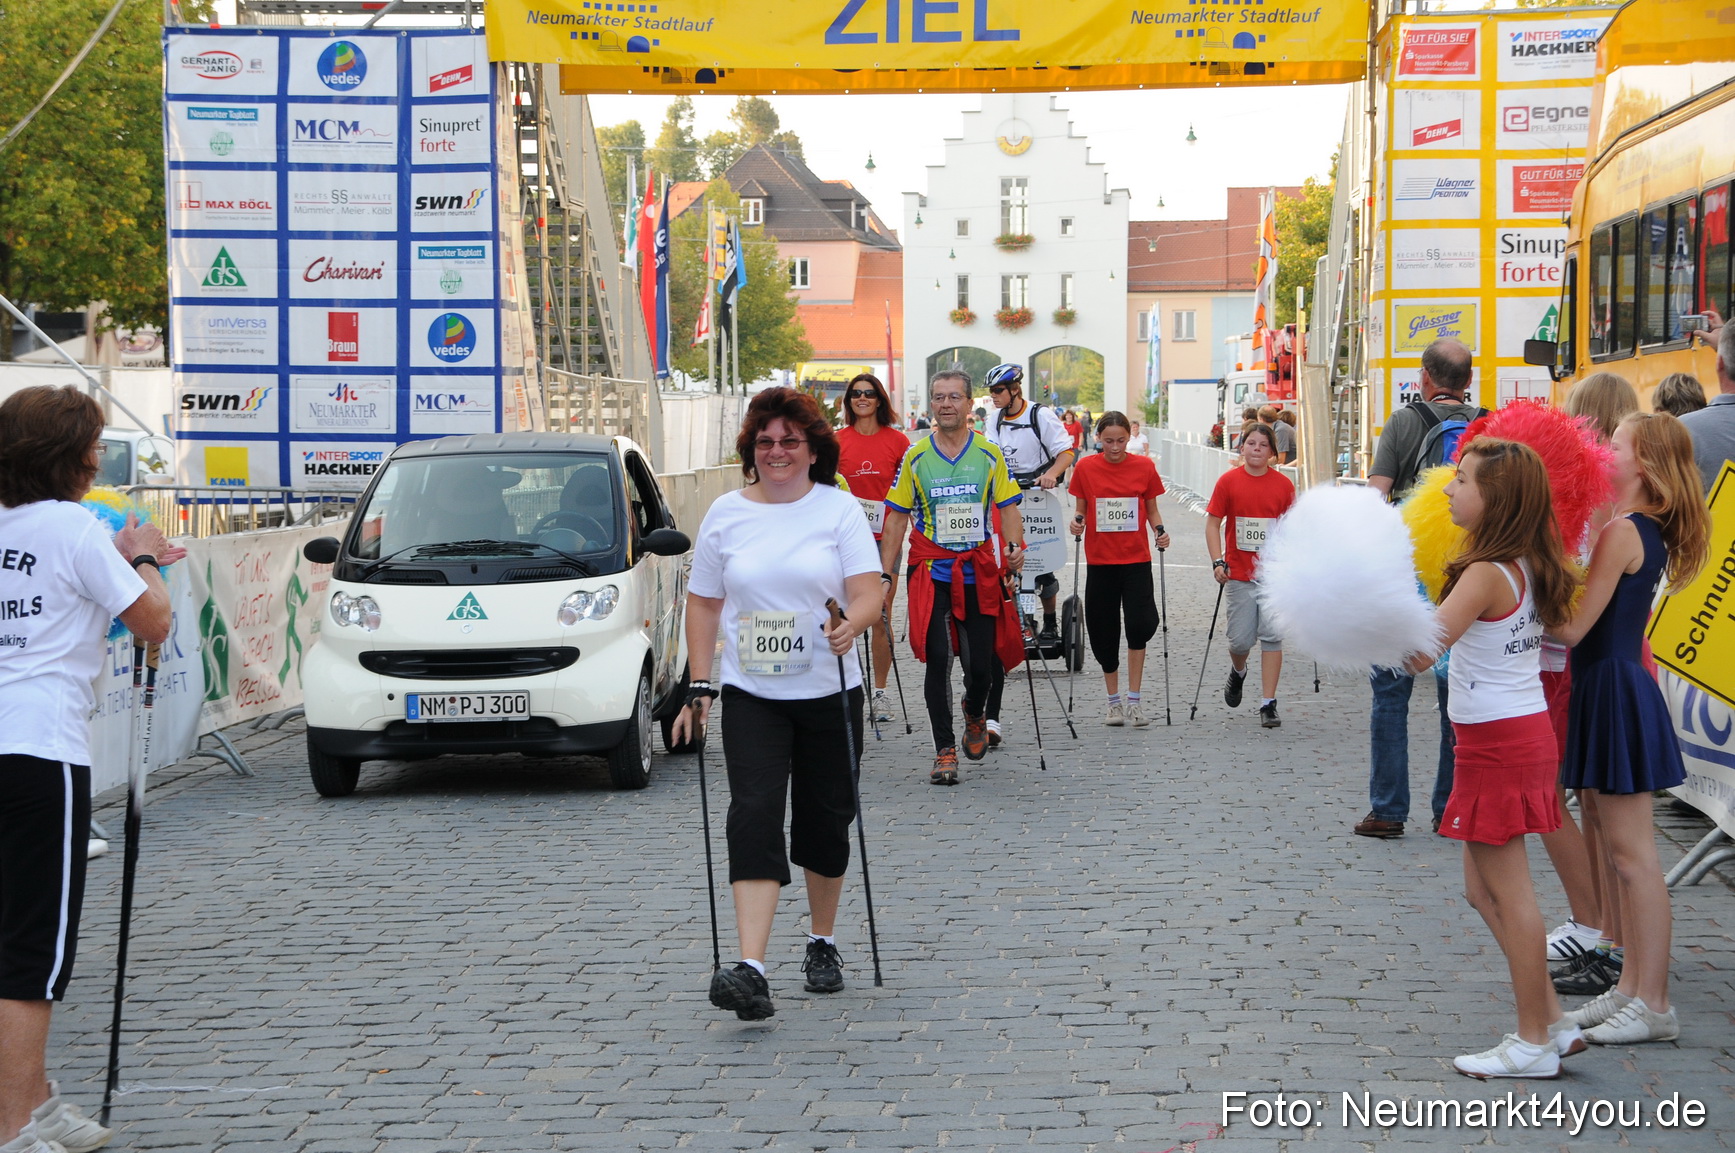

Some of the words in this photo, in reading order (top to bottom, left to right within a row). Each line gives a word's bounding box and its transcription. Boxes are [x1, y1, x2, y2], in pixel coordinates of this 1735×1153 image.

[526, 10, 628, 28] Neumarkter
[633, 15, 714, 32] Stadtlauf
[1130, 7, 1234, 24] Neumarkter
[1239, 7, 1322, 23] Stadtlauf
[1405, 34, 1426, 43] GUT
[1427, 32, 1448, 43] FÜR
[1449, 32, 1470, 43] SIE!
[1524, 28, 1598, 42] INTERSPORT
[1511, 41, 1597, 57] HACKNER
[181, 56, 230, 65] GERHART
[204, 65, 237, 73] JANIG
[322, 72, 361, 85] vedes
[440, 72, 461, 86] DEHN
[294, 118, 360, 141] MCM
[419, 117, 481, 136] Sinupret
[1425, 126, 1449, 139] DEHN
[420, 137, 456, 153] forte
[1520, 170, 1541, 180] GUT
[1543, 168, 1564, 179] FÜR
[1436, 177, 1475, 190] Wagner
[205, 200, 235, 209] MAX
[239, 198, 273, 210] BÖGL
[415, 195, 463, 210] swn
[420, 248, 456, 257] Neumarkter
[302, 256, 385, 283] Charivari
[1501, 261, 1560, 282] forte
[1408, 310, 1462, 339] Glossner
[1436, 326, 1461, 338] Bier
[328, 338, 357, 353] Braun
[433, 343, 471, 356] vedes
[181, 393, 240, 411] swn
[415, 393, 466, 410] MCM
[315, 451, 384, 461] INTERSPORT
[210, 477, 246, 486] KANN
[930, 484, 978, 498] BOCK
[948, 505, 972, 515] Richard
[1108, 510, 1135, 520] 8064
[950, 517, 980, 530] 8089
[1030, 526, 1056, 535] Partl
[0, 548, 37, 577] ER
[755, 615, 795, 632] Irmgard
[756, 636, 805, 653] 8004
[420, 697, 446, 716] NM
[490, 695, 526, 714] 300
